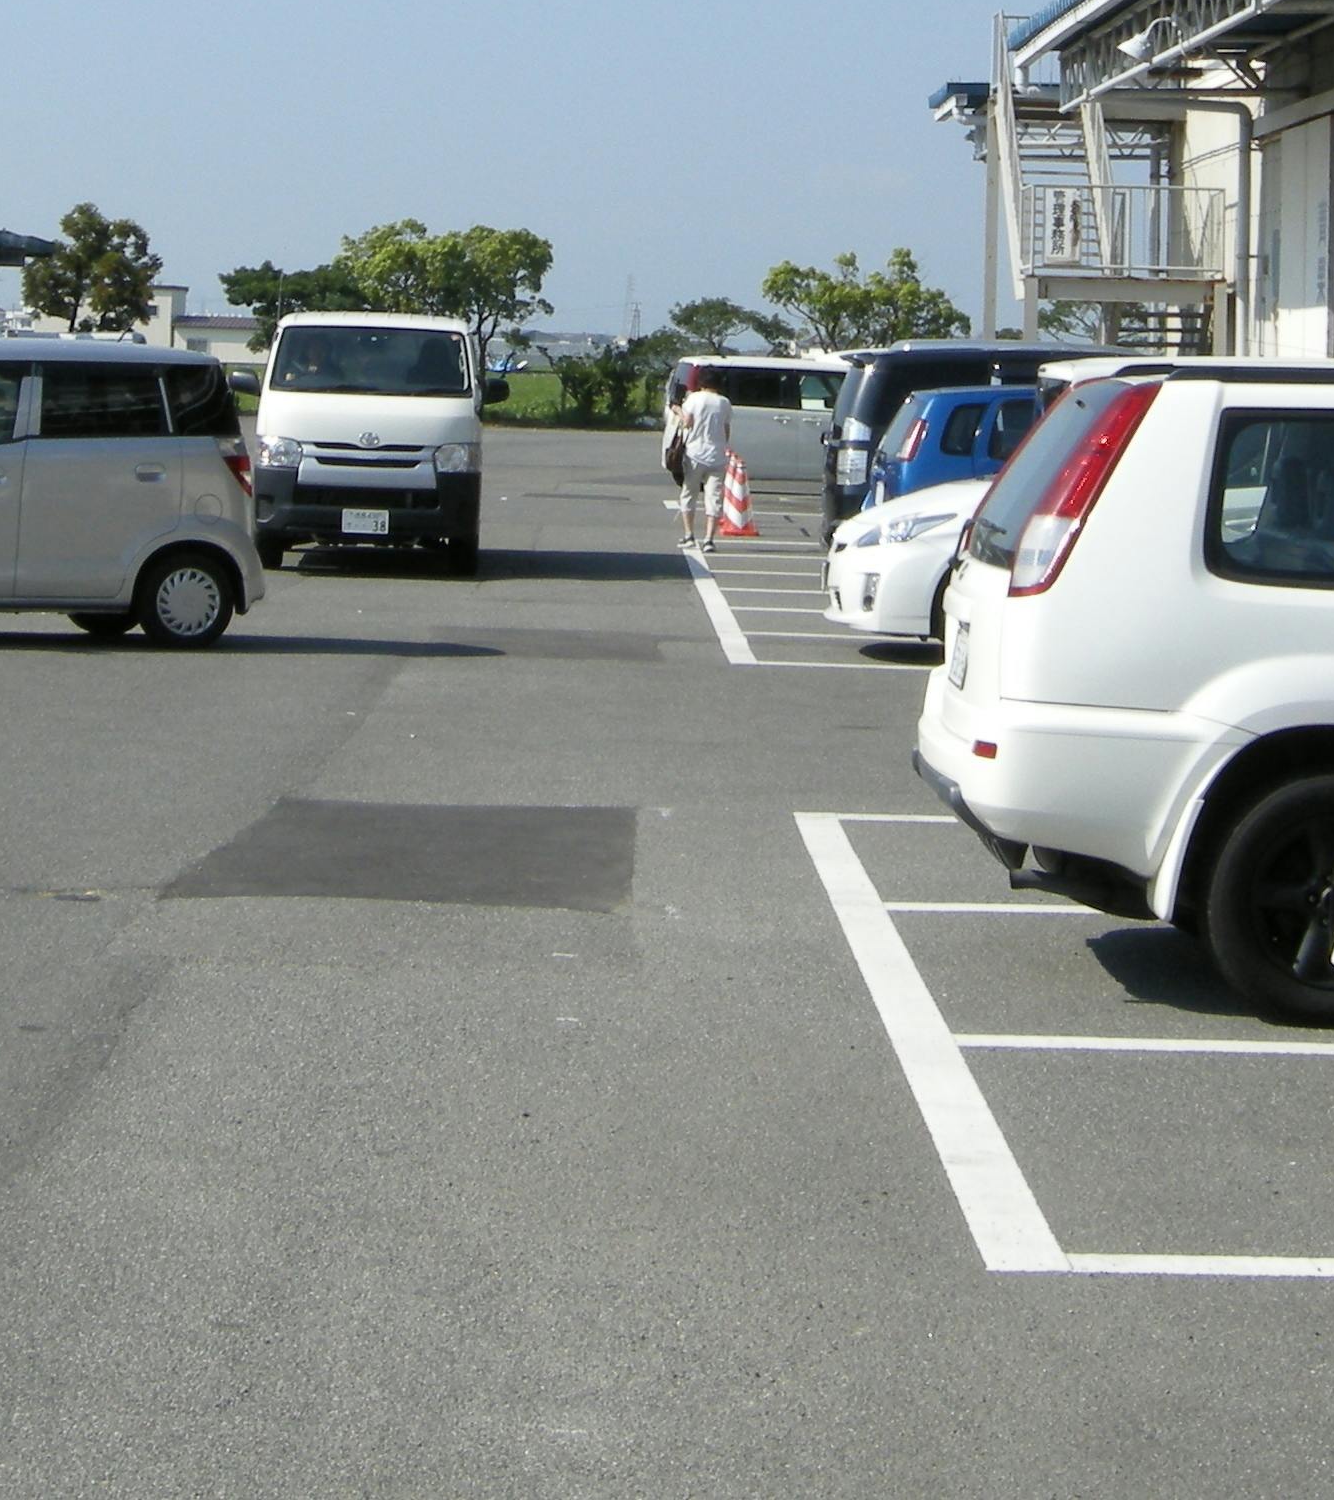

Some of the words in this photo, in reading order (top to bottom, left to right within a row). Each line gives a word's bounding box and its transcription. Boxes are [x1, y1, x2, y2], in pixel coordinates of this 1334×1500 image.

[1051, 190, 1066, 255] 管理事務所
